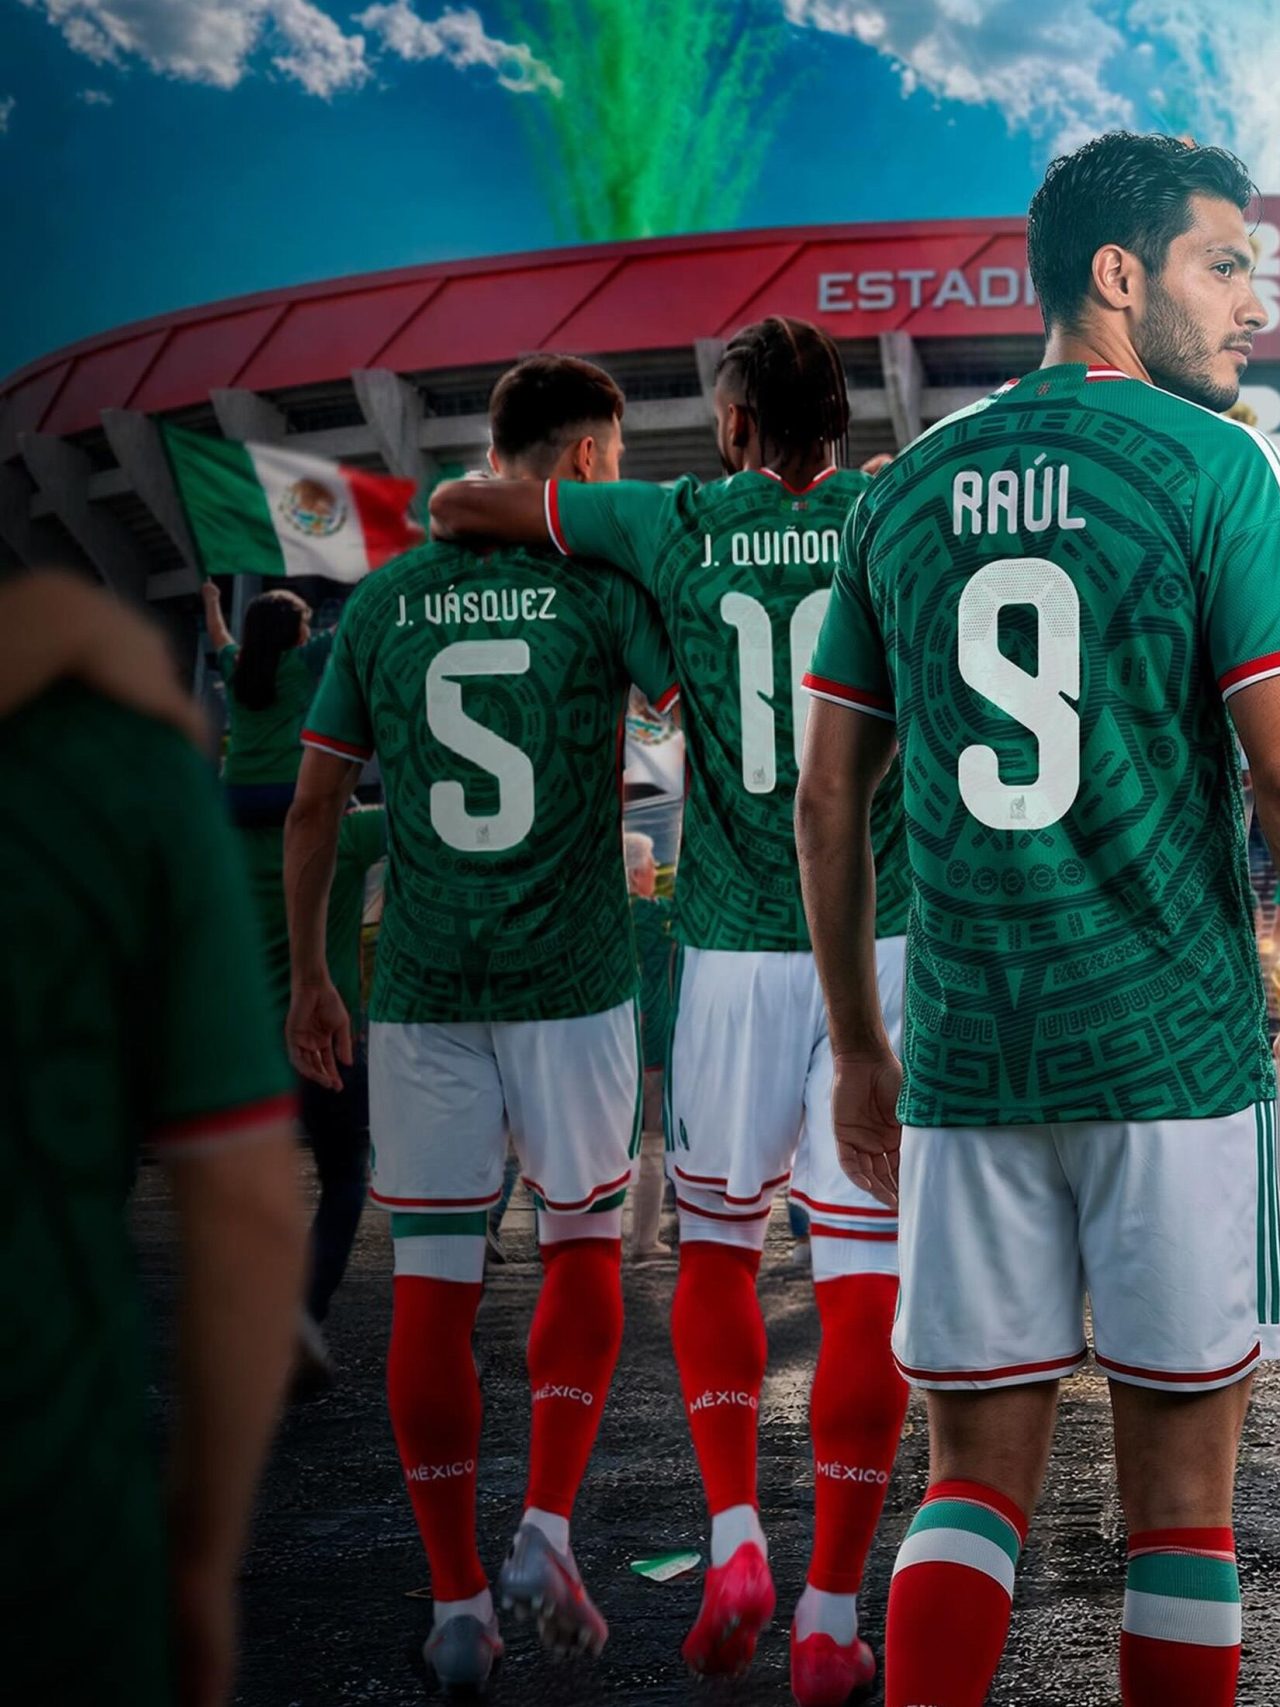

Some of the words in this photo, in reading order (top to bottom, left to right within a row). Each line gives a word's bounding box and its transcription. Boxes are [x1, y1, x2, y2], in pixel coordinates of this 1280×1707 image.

[818, 267, 1037, 312] ESTADI
[953, 453, 1086, 535] RAÚL
[700, 533, 720, 568] J.
[732, 525, 839, 566] QUIÑON
[395, 594, 415, 627] J.
[424, 584, 558, 626] VÁSQUEZ
[958, 557, 1080, 830] 9
[426, 639, 535, 852] 5
[532, 1382, 593, 1406] MÉXICO
[690, 1389, 757, 1415] MÉXICO
[407, 1459, 474, 1482] MÉXICO
[817, 1461, 888, 1485] MÉXICO
